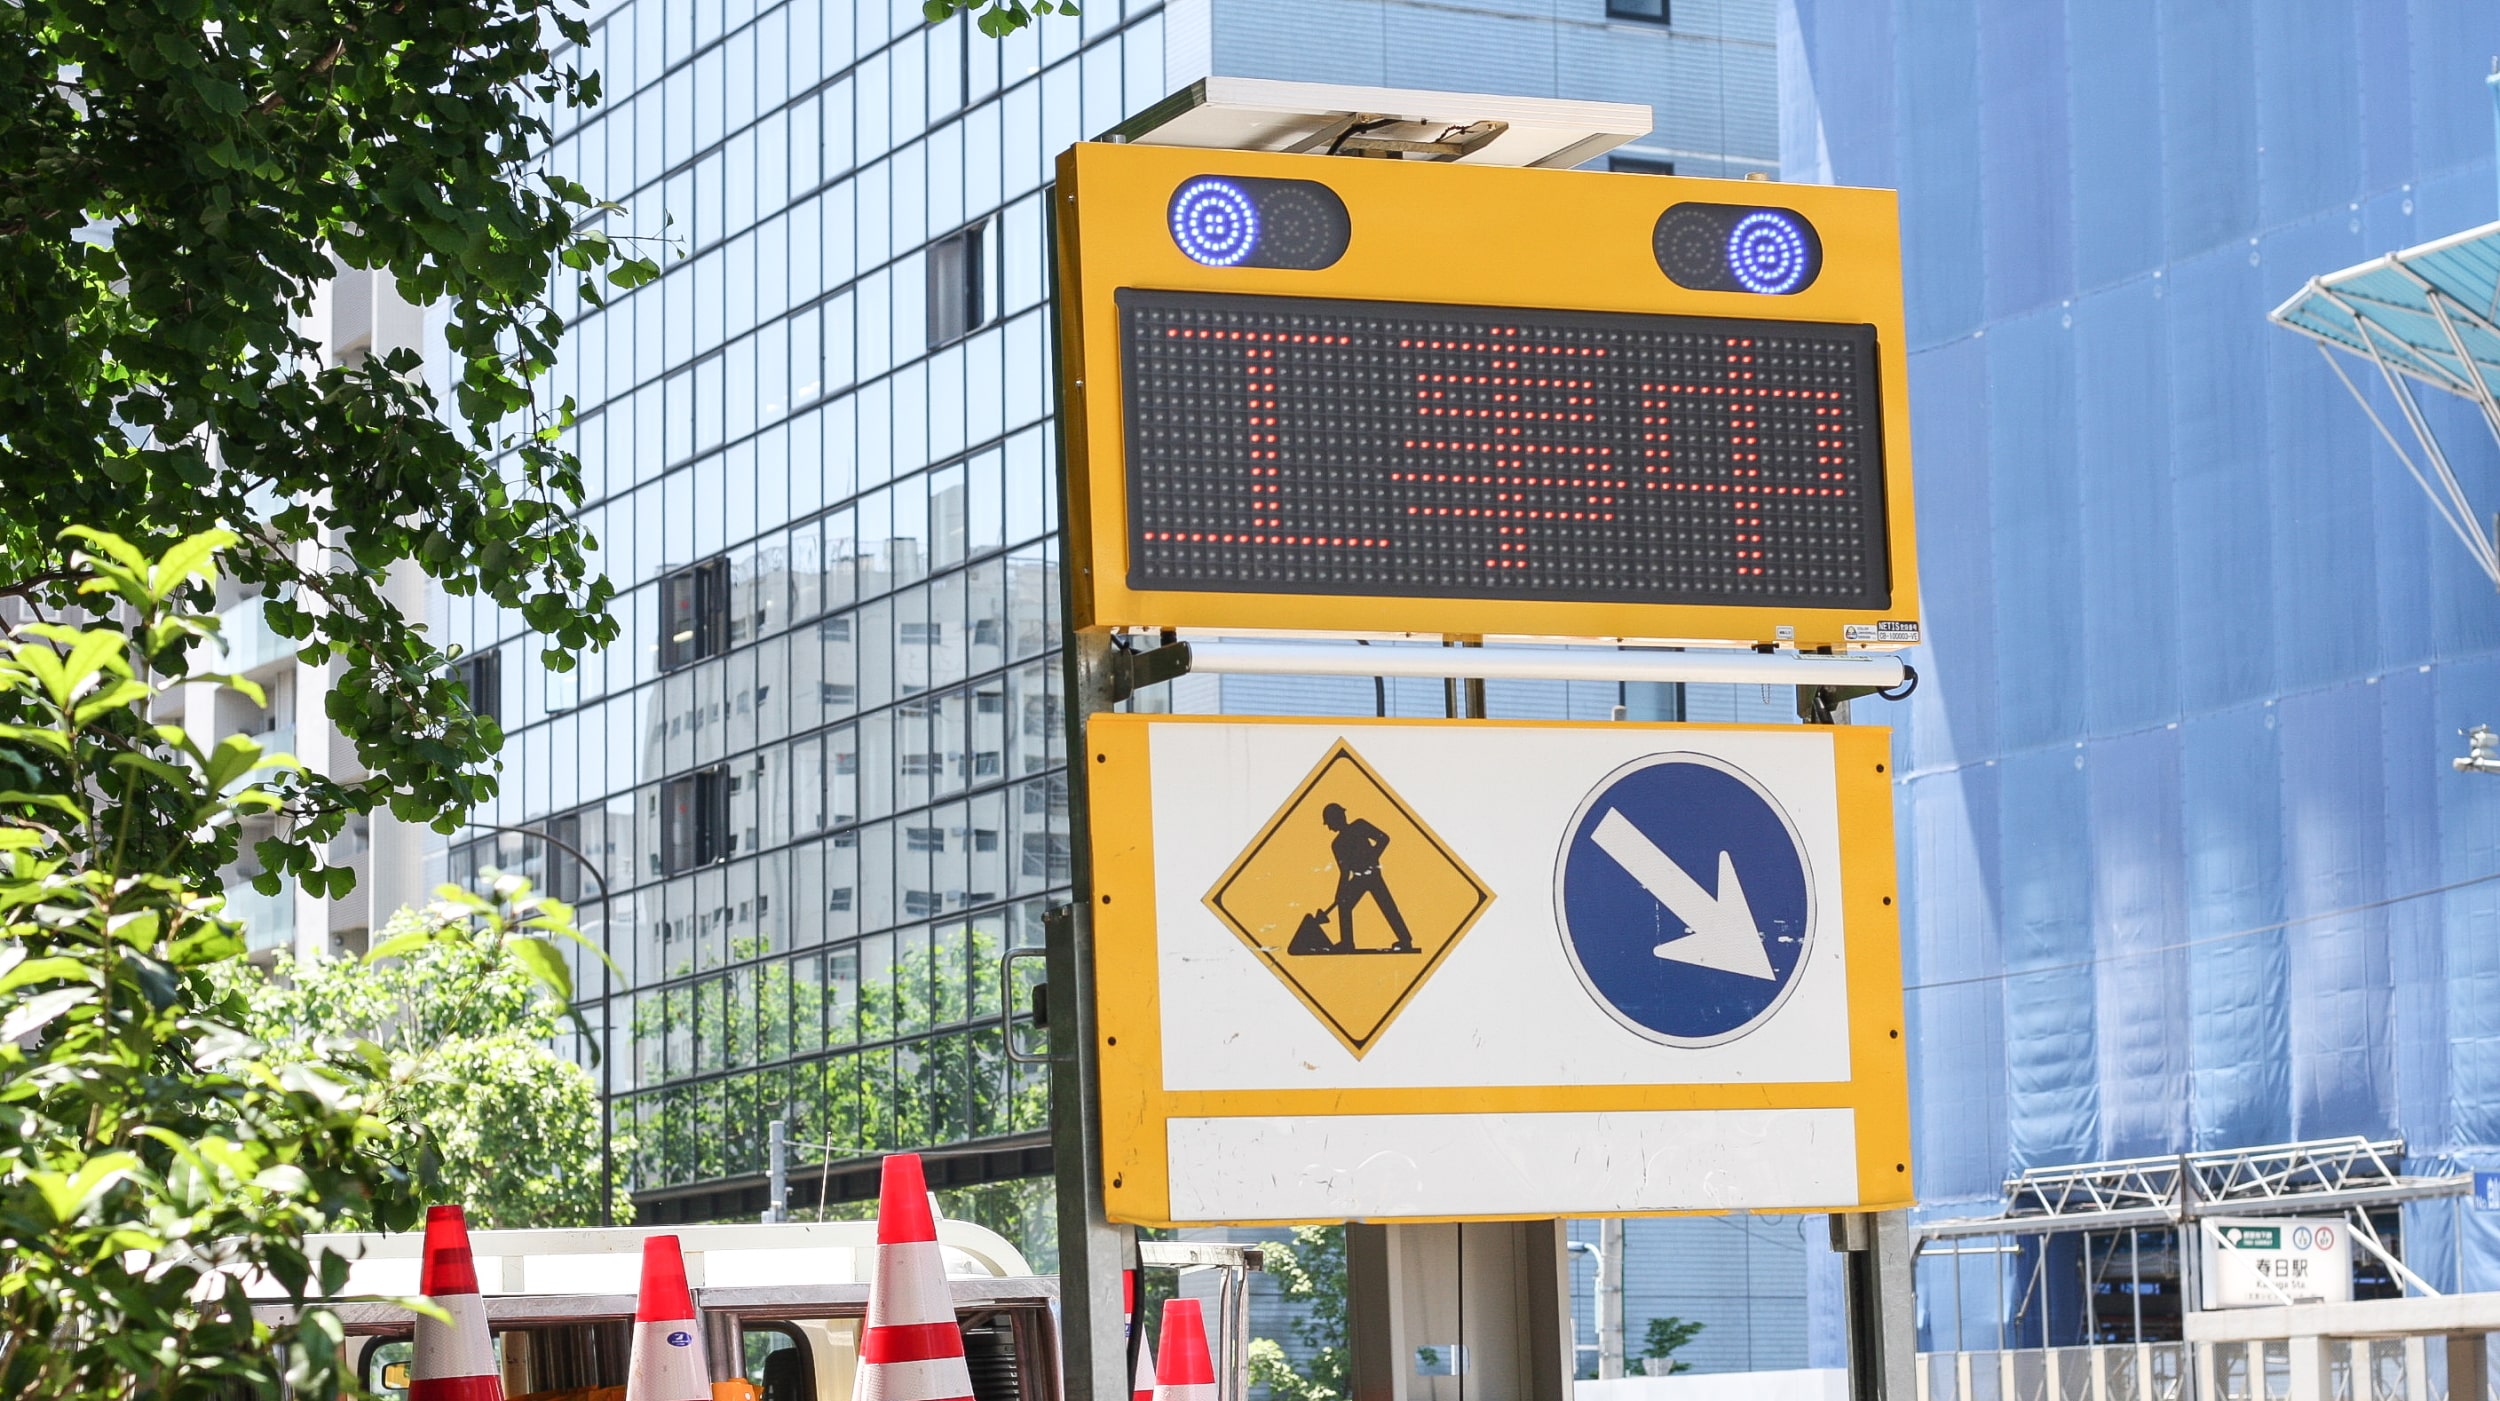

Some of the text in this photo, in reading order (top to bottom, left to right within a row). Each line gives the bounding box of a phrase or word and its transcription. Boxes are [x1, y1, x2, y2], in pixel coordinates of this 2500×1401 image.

[1144, 326, 1847, 576] 工事中
[2256, 1258, 2308, 1278] 春日駅
